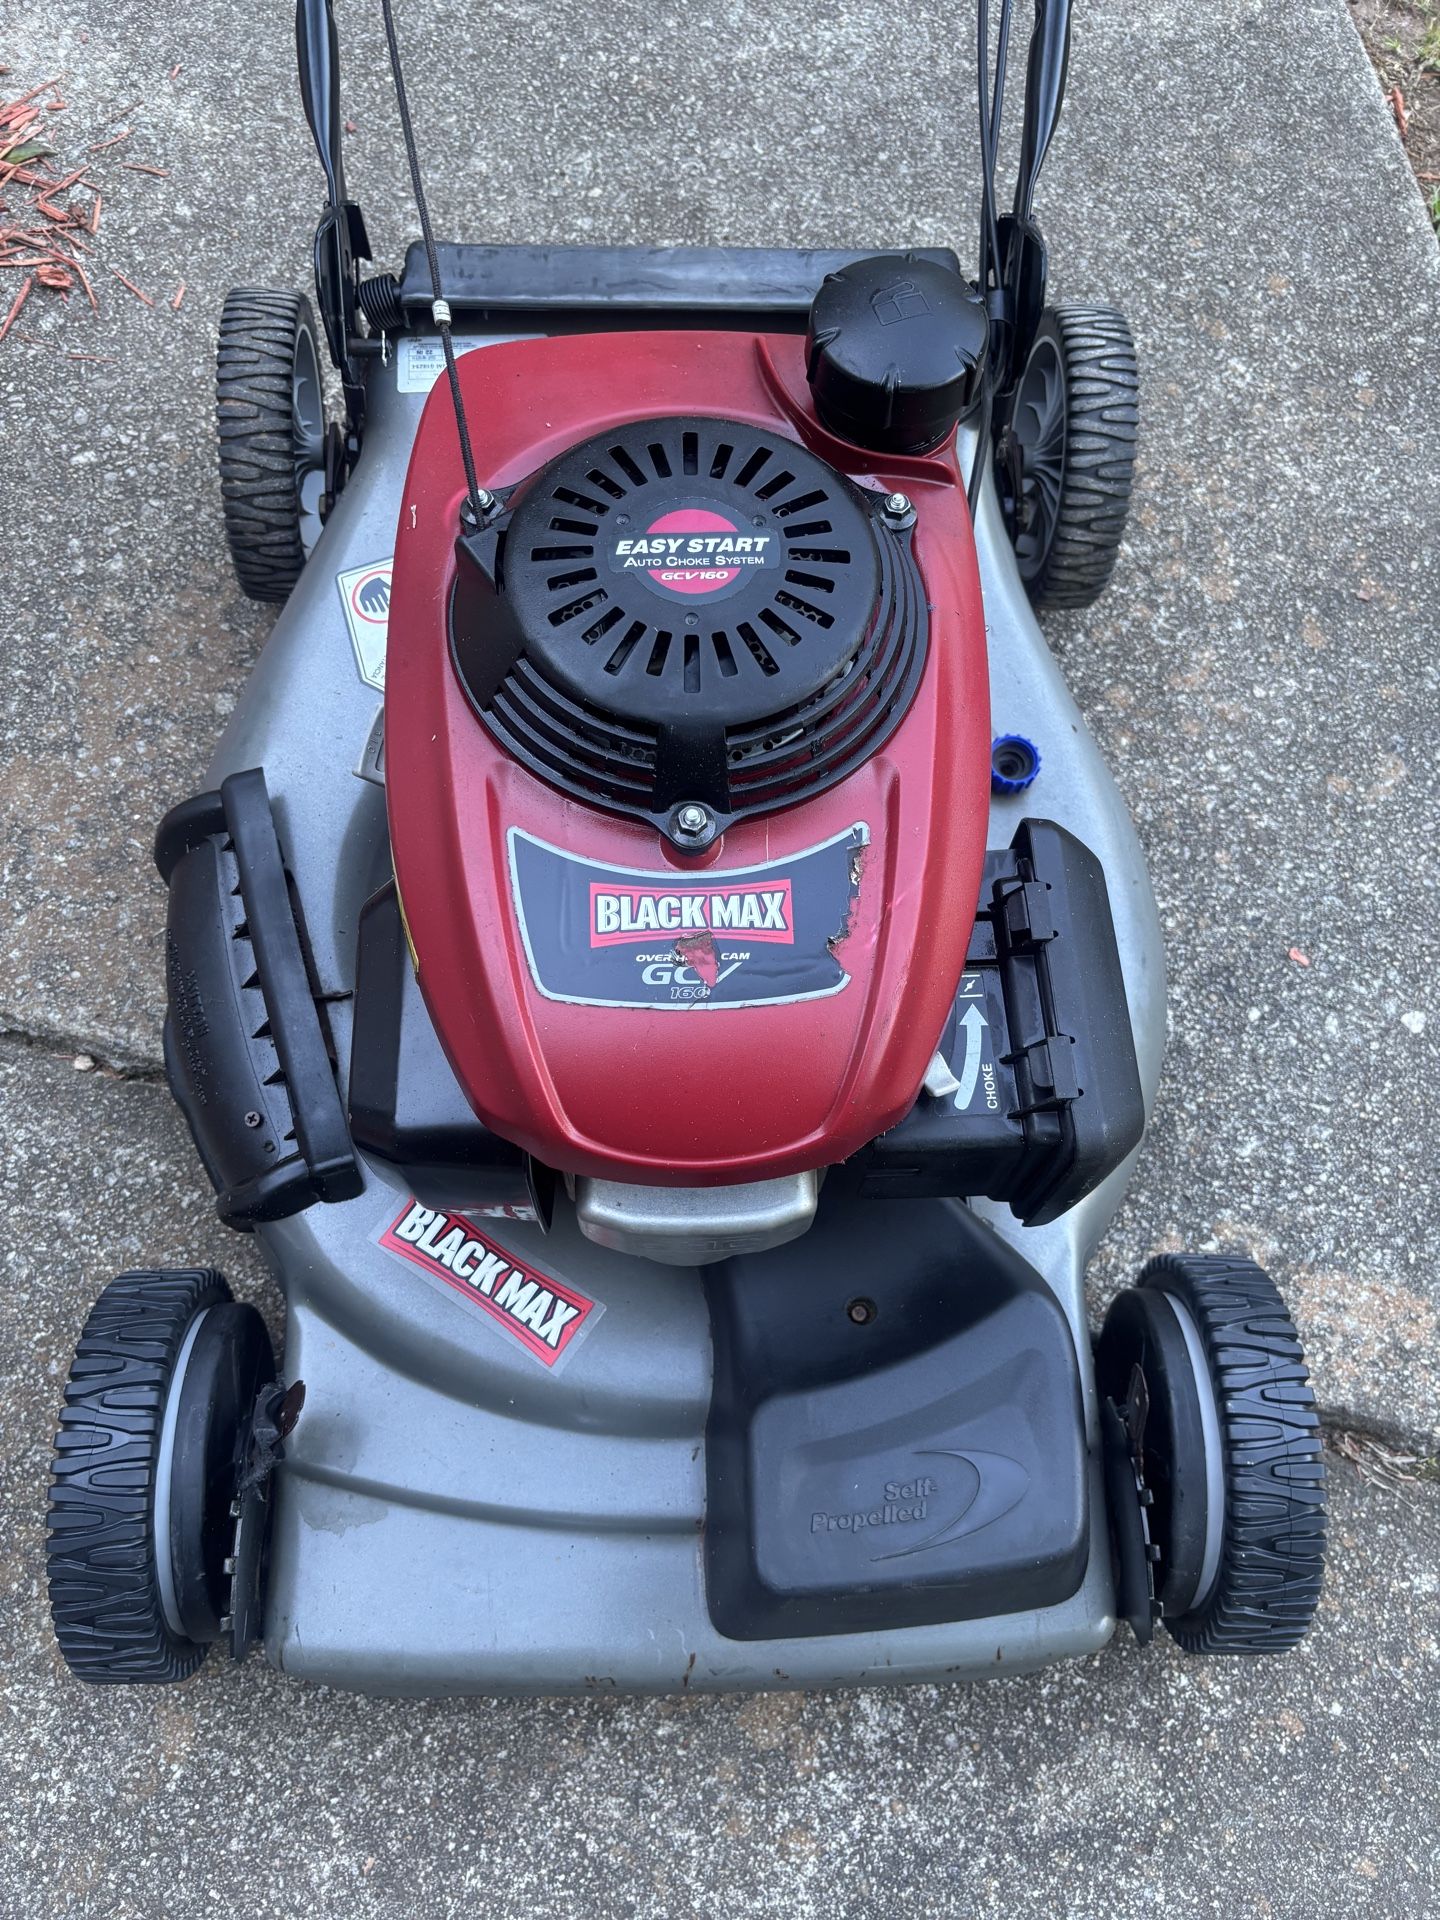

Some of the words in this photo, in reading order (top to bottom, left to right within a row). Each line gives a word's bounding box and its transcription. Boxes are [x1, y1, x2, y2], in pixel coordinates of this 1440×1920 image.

[615, 538, 685, 555] EASY
[686, 537, 770, 553] START
[623, 556, 661, 567] AUTO
[665, 556, 710, 566] CHOKE
[715, 555, 764, 565] SYSTEM
[661, 571, 728, 581] GCV160
[596, 894, 706, 933] BLACK
[712, 892, 787, 930] MAX
[636, 954, 671, 962] OVER
[721, 952, 750, 960] CAM
[671, 987, 711, 999] 160
[982, 1063, 997, 1109] CHOKE
[395, 1201, 510, 1296] BLACK
[493, 1270, 580, 1349] MAX
[884, 1477, 938, 1501] Self-
[810, 1501, 927, 1534] Propelled
